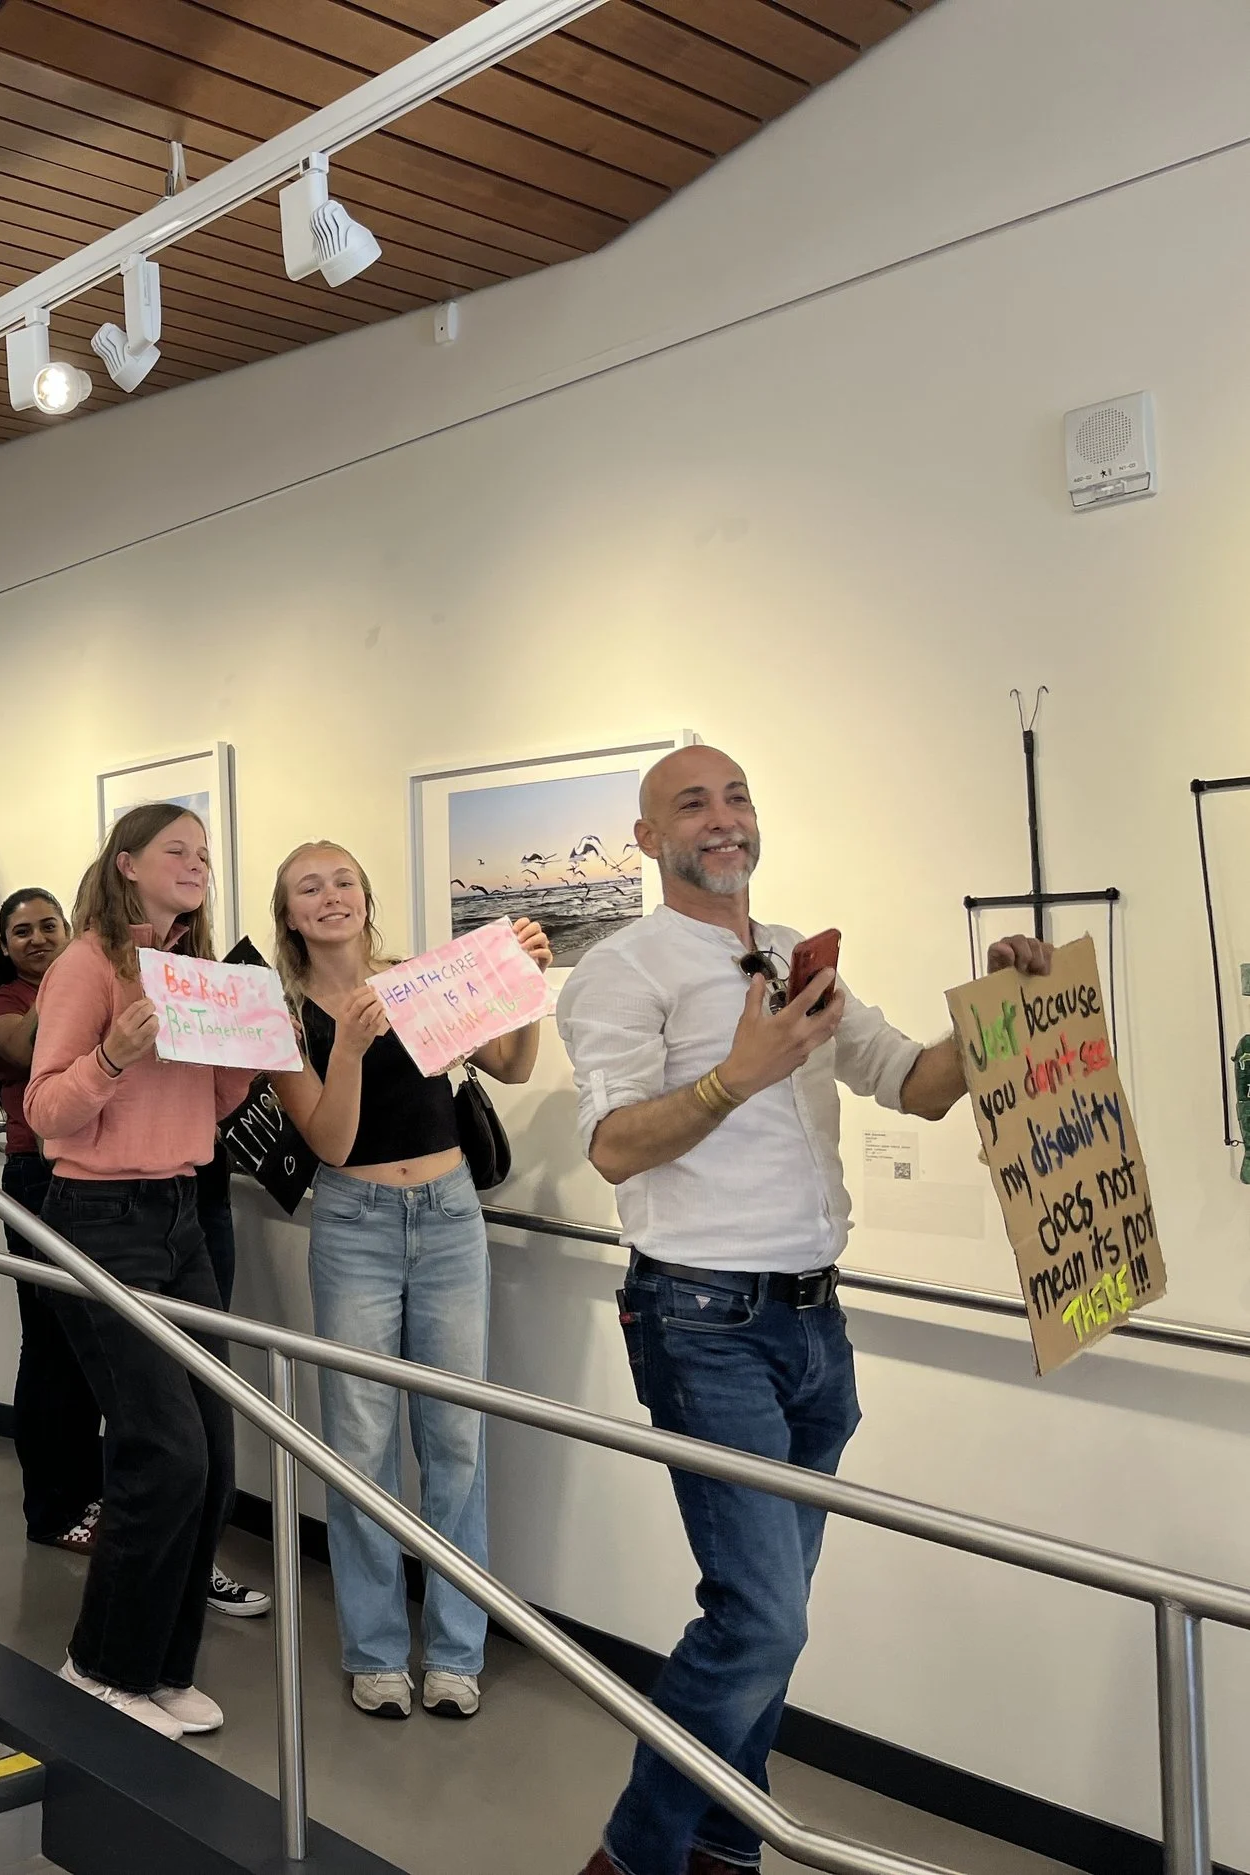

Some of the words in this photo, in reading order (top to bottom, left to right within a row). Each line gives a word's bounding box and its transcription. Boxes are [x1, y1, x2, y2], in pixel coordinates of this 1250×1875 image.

[163, 963, 192, 996] Be
[379, 951, 479, 1009] HEALTHCARE
[443, 989, 459, 1012] IS
[466, 981, 479, 997] A
[165, 1004, 193, 1055] Be
[189, 1007, 263, 1047] Together
[1020, 984, 1100, 1040] because
[979, 1080, 1016, 1146] you
[1000, 1153, 1033, 1206] my
[1027, 1088, 1126, 1177] disability
[1038, 1180, 1094, 1256] does
[1096, 1154, 1136, 1210] not
[1029, 1250, 1087, 1320] mean
[1122, 1192, 1154, 1262] not
